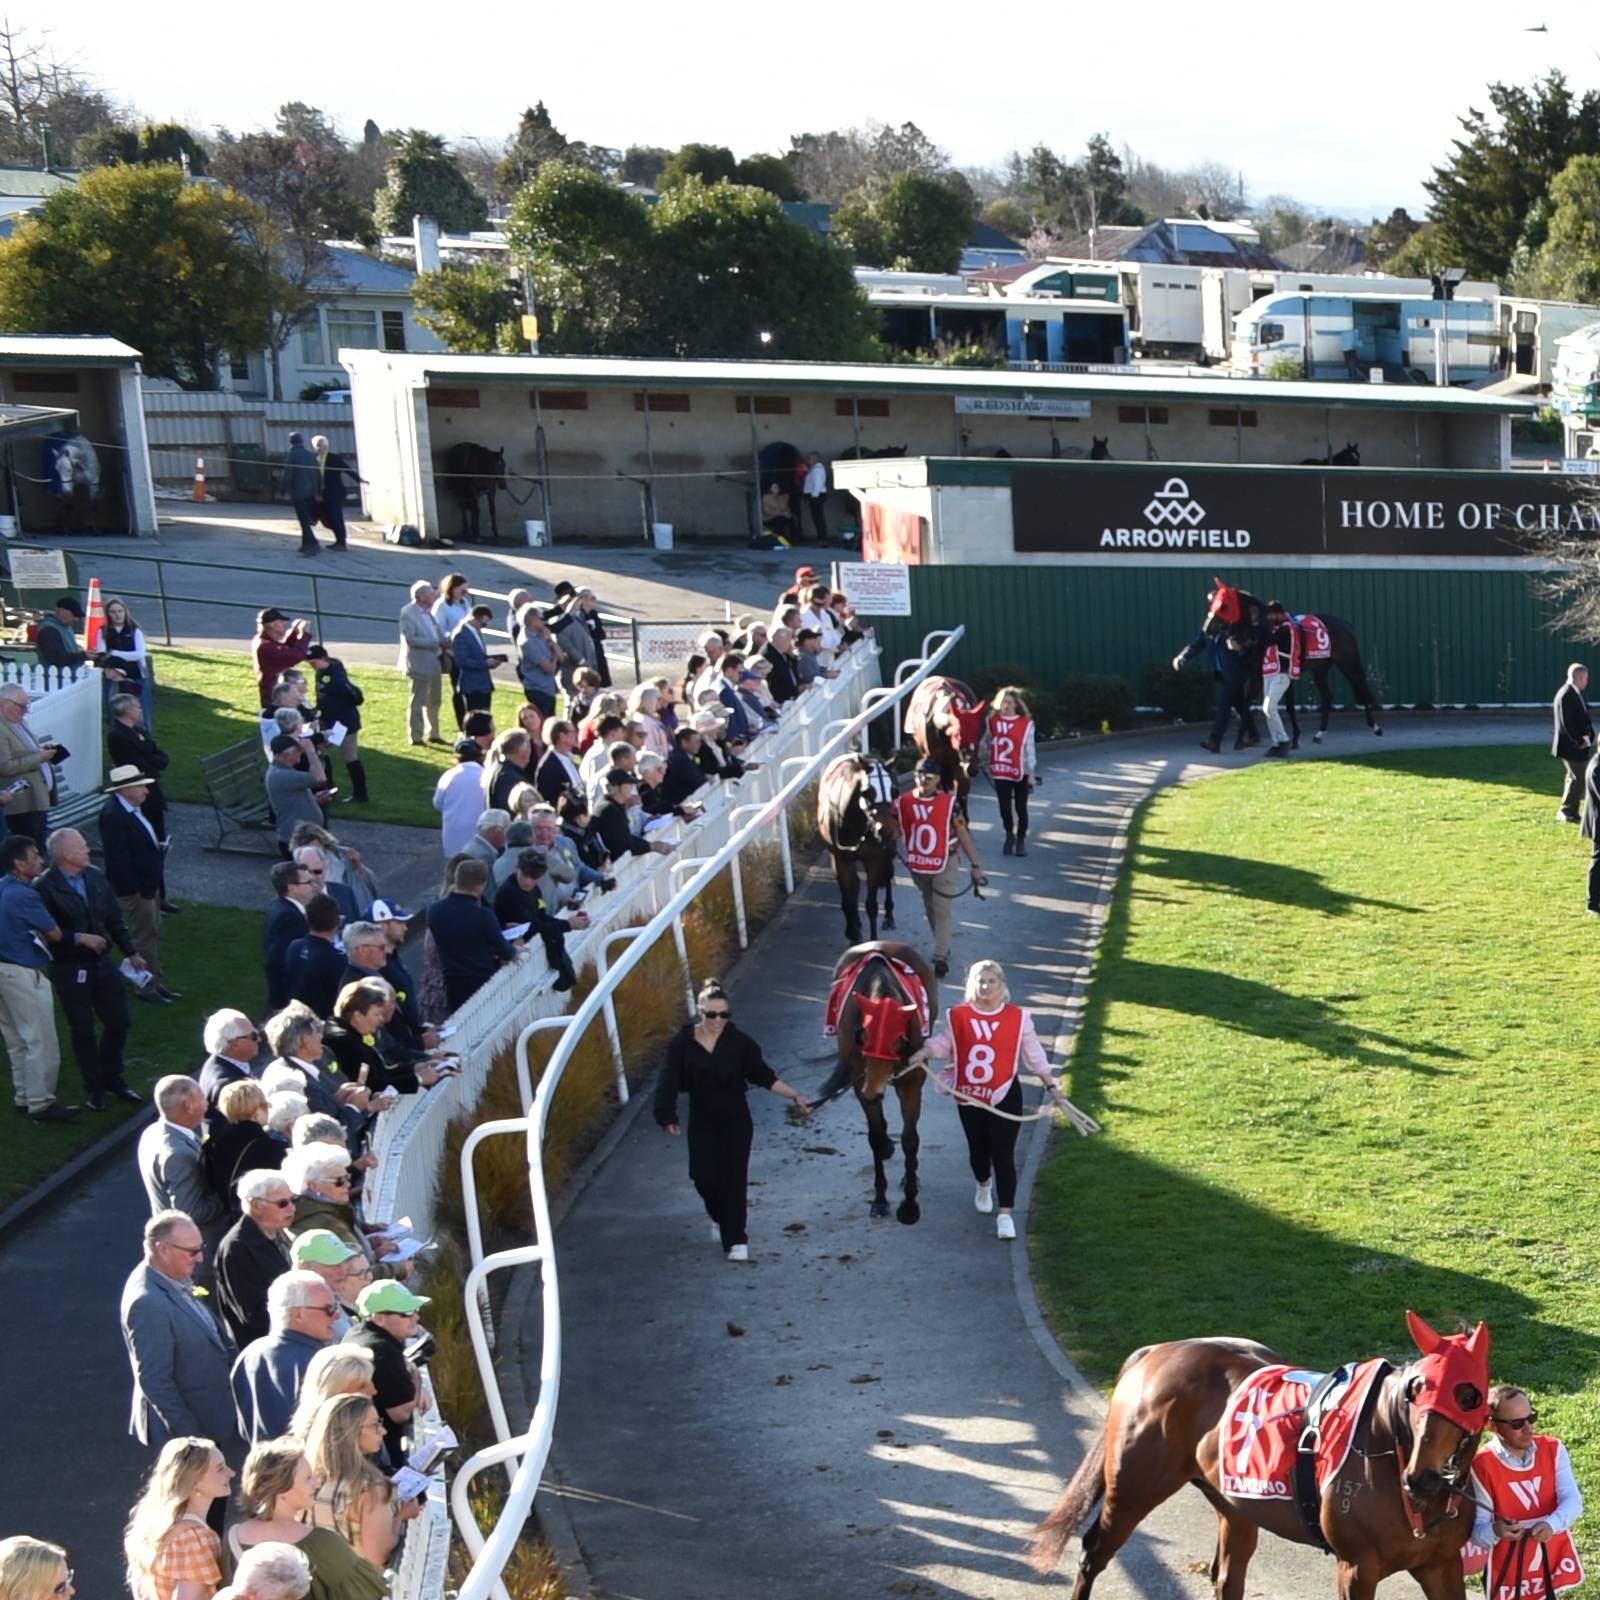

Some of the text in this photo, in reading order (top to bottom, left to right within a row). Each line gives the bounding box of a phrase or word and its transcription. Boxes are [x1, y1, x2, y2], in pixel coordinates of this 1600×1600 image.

[973, 399, 1043, 412] REDSHAW
[1340, 501, 1445, 530] HOME
[1458, 502, 1501, 530] OF
[1100, 528, 1251, 549] ARROWFIELD
[1316, 627, 1330, 650] 9
[991, 737, 1015, 764] 12
[909, 823, 938, 855] 10
[904, 854, 943, 867] RZINO
[965, 1043, 996, 1084] 8
[1224, 1476, 1287, 1495] TARZINO
[1335, 1478, 1363, 1498] 157
[1341, 1500, 1351, 1514] 9
